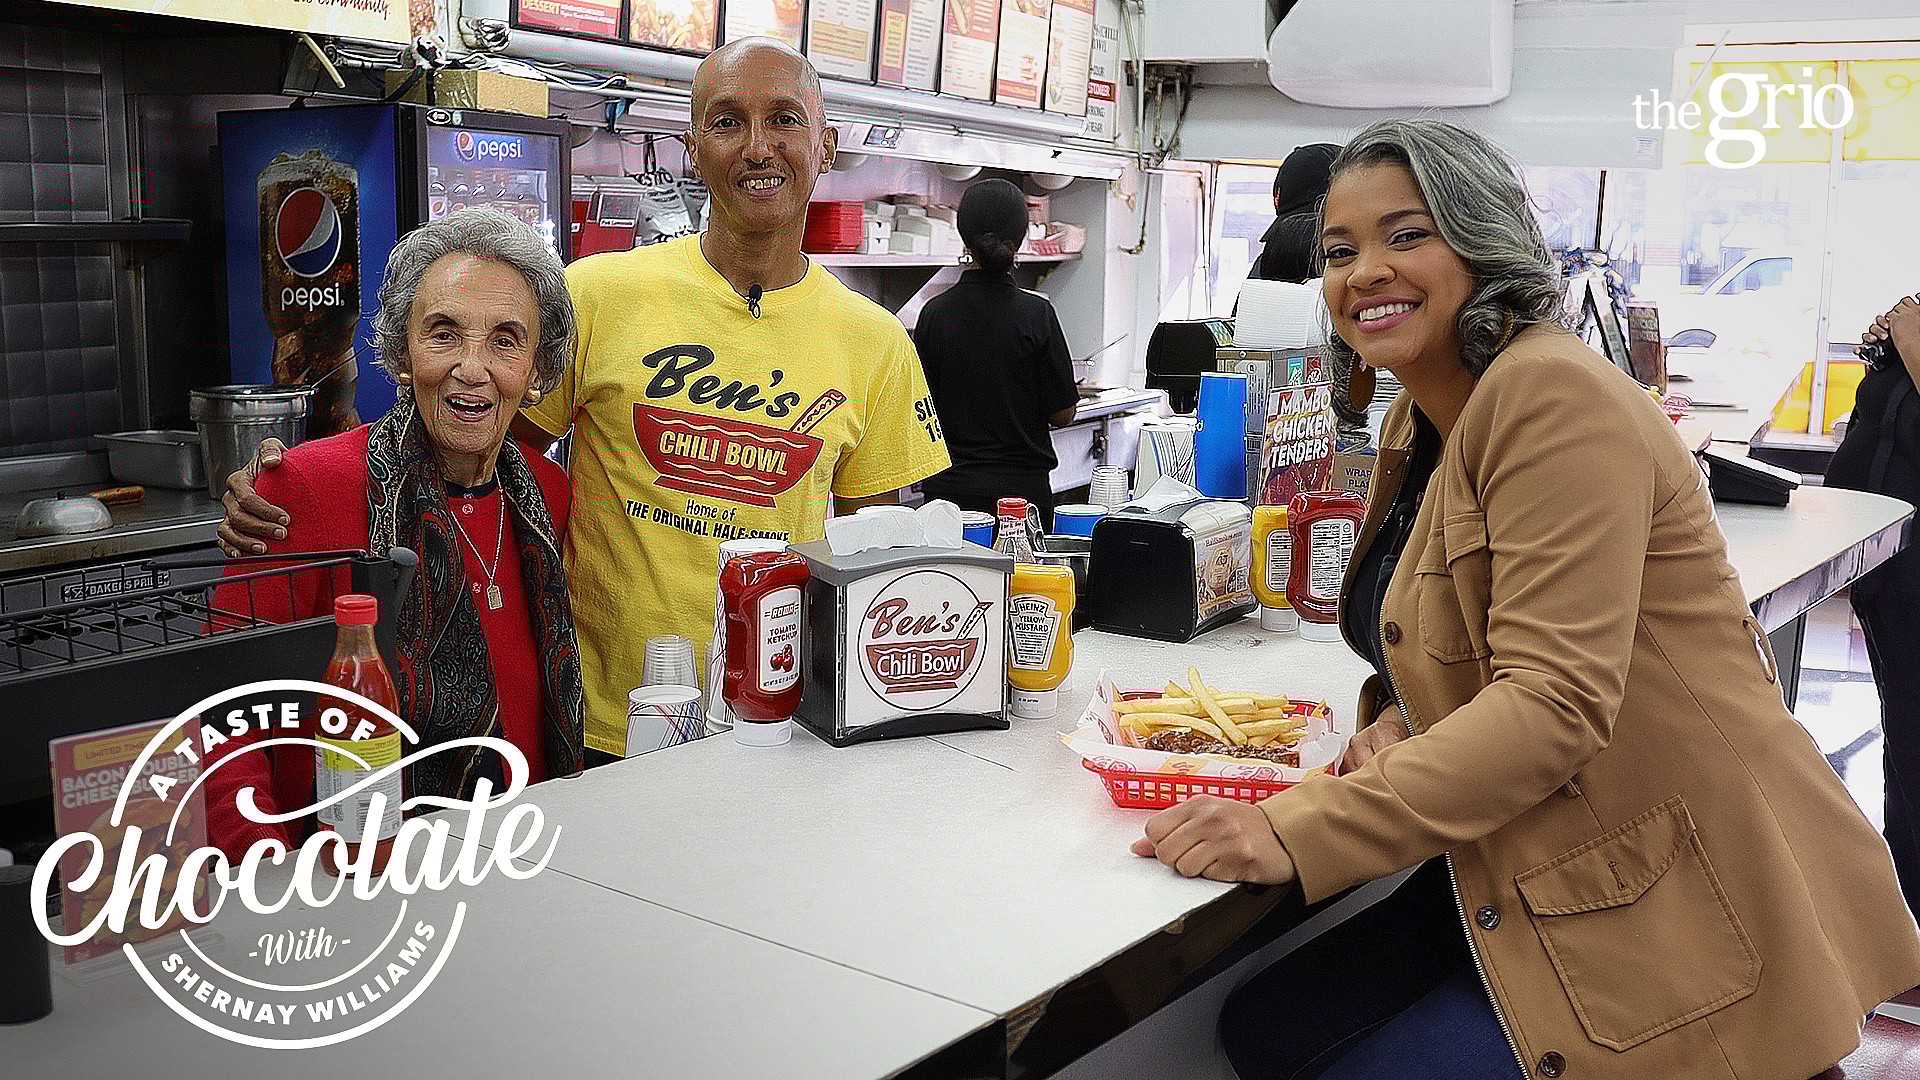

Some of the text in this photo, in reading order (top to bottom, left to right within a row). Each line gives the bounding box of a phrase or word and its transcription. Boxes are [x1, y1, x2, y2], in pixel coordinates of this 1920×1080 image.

[477, 138, 522, 162] pepsi
[281, 282, 340, 311] pepsi
[642, 344, 800, 418] Ben's
[1280, 391, 1332, 417] MAMBO
[1273, 412, 1333, 444] CHICKEN
[659, 430, 788, 476] CHILI BOWL
[1271, 437, 1329, 469] TENDERS
[625, 500, 650, 520] THE
[652, 507, 710, 537] ORIGINAL
[685, 498, 738, 522] Home of
[867, 598, 961, 640] Ben's
[1019, 602, 1046, 614] HEINZ
[1019, 615, 1045, 624] YELLOW
[767, 630, 798, 645] KETCHUP
[769, 623, 797, 637] TOMATO
[1015, 622, 1049, 633] MUSTARD
[877, 649, 965, 677] Chili Bowl
[61, 767, 126, 794] BACON
